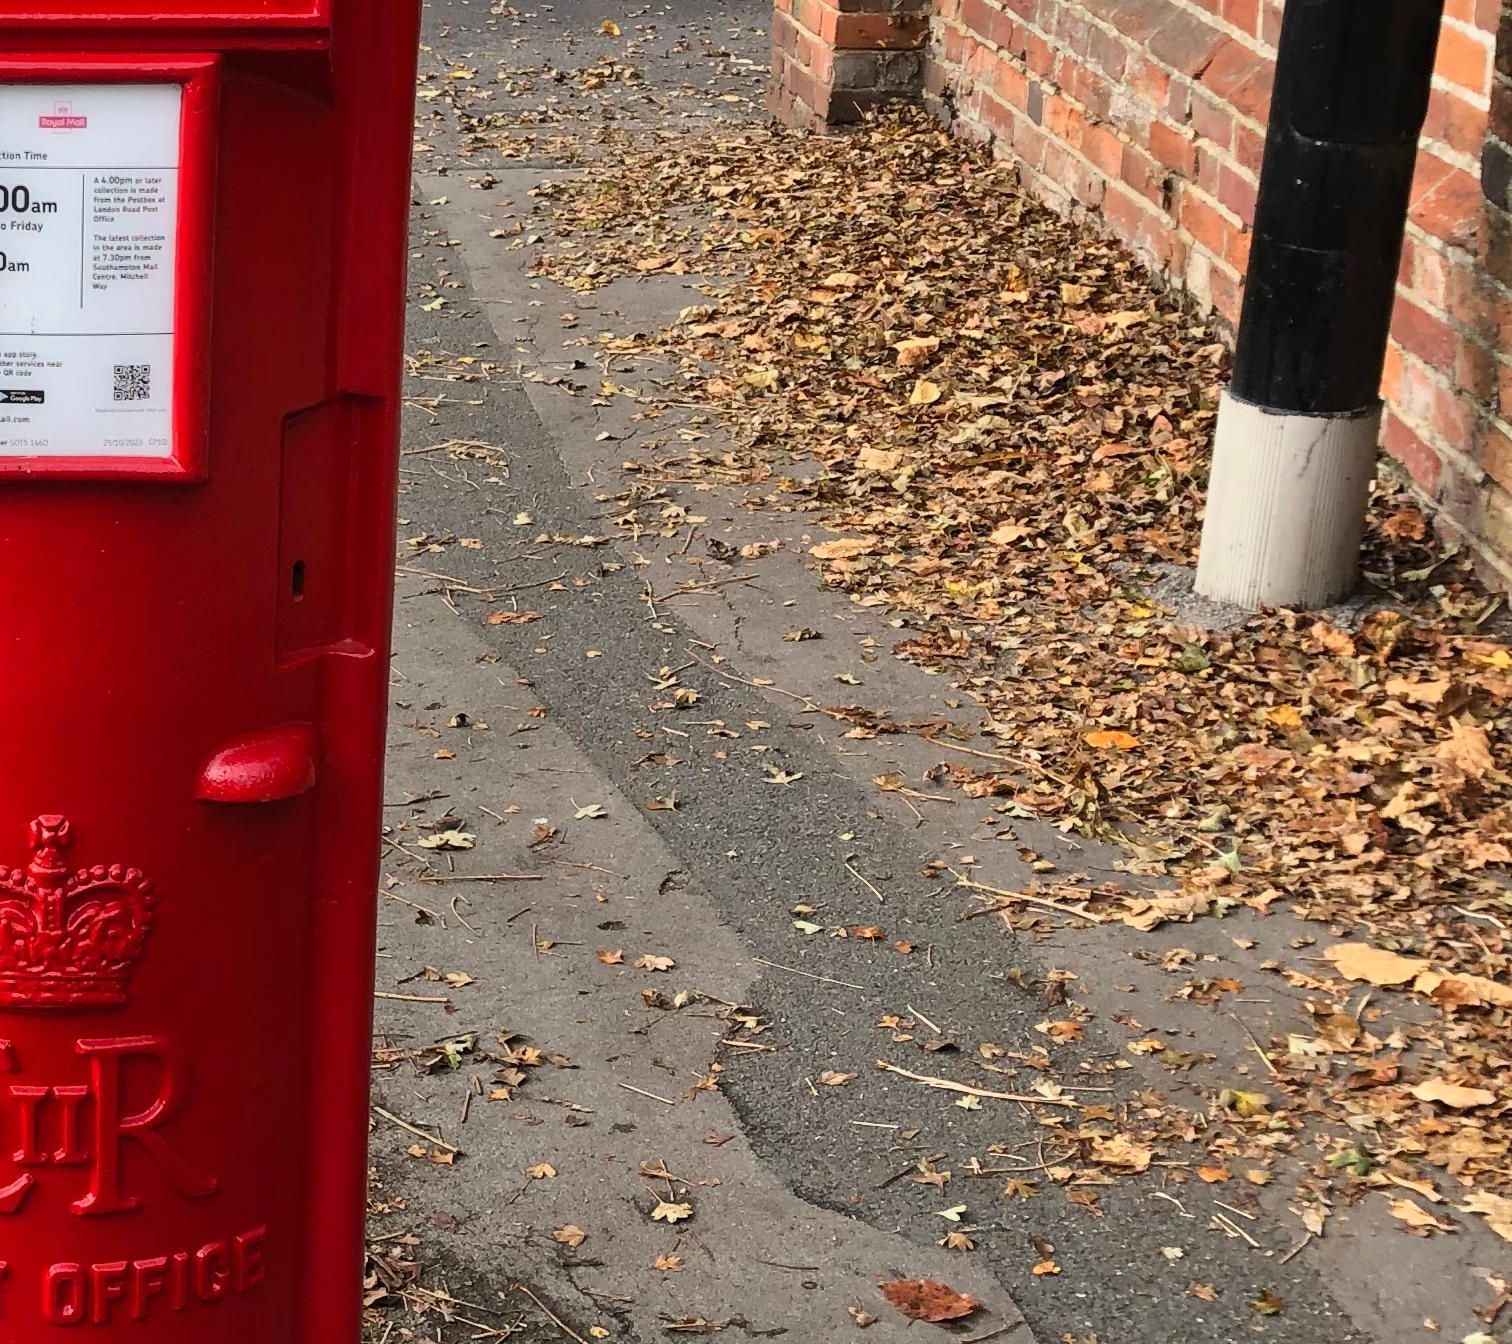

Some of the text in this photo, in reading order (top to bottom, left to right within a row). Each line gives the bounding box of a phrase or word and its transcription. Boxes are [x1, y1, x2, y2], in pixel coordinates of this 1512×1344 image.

[41, 118, 85, 127] Royal Mail
[24, 150, 48, 161] Time
[10, 221, 44, 233] Friday
[93, 234, 107, 242] The
[92, 283, 108, 291] Way
[42, 1223, 268, 1324] OFFICE
